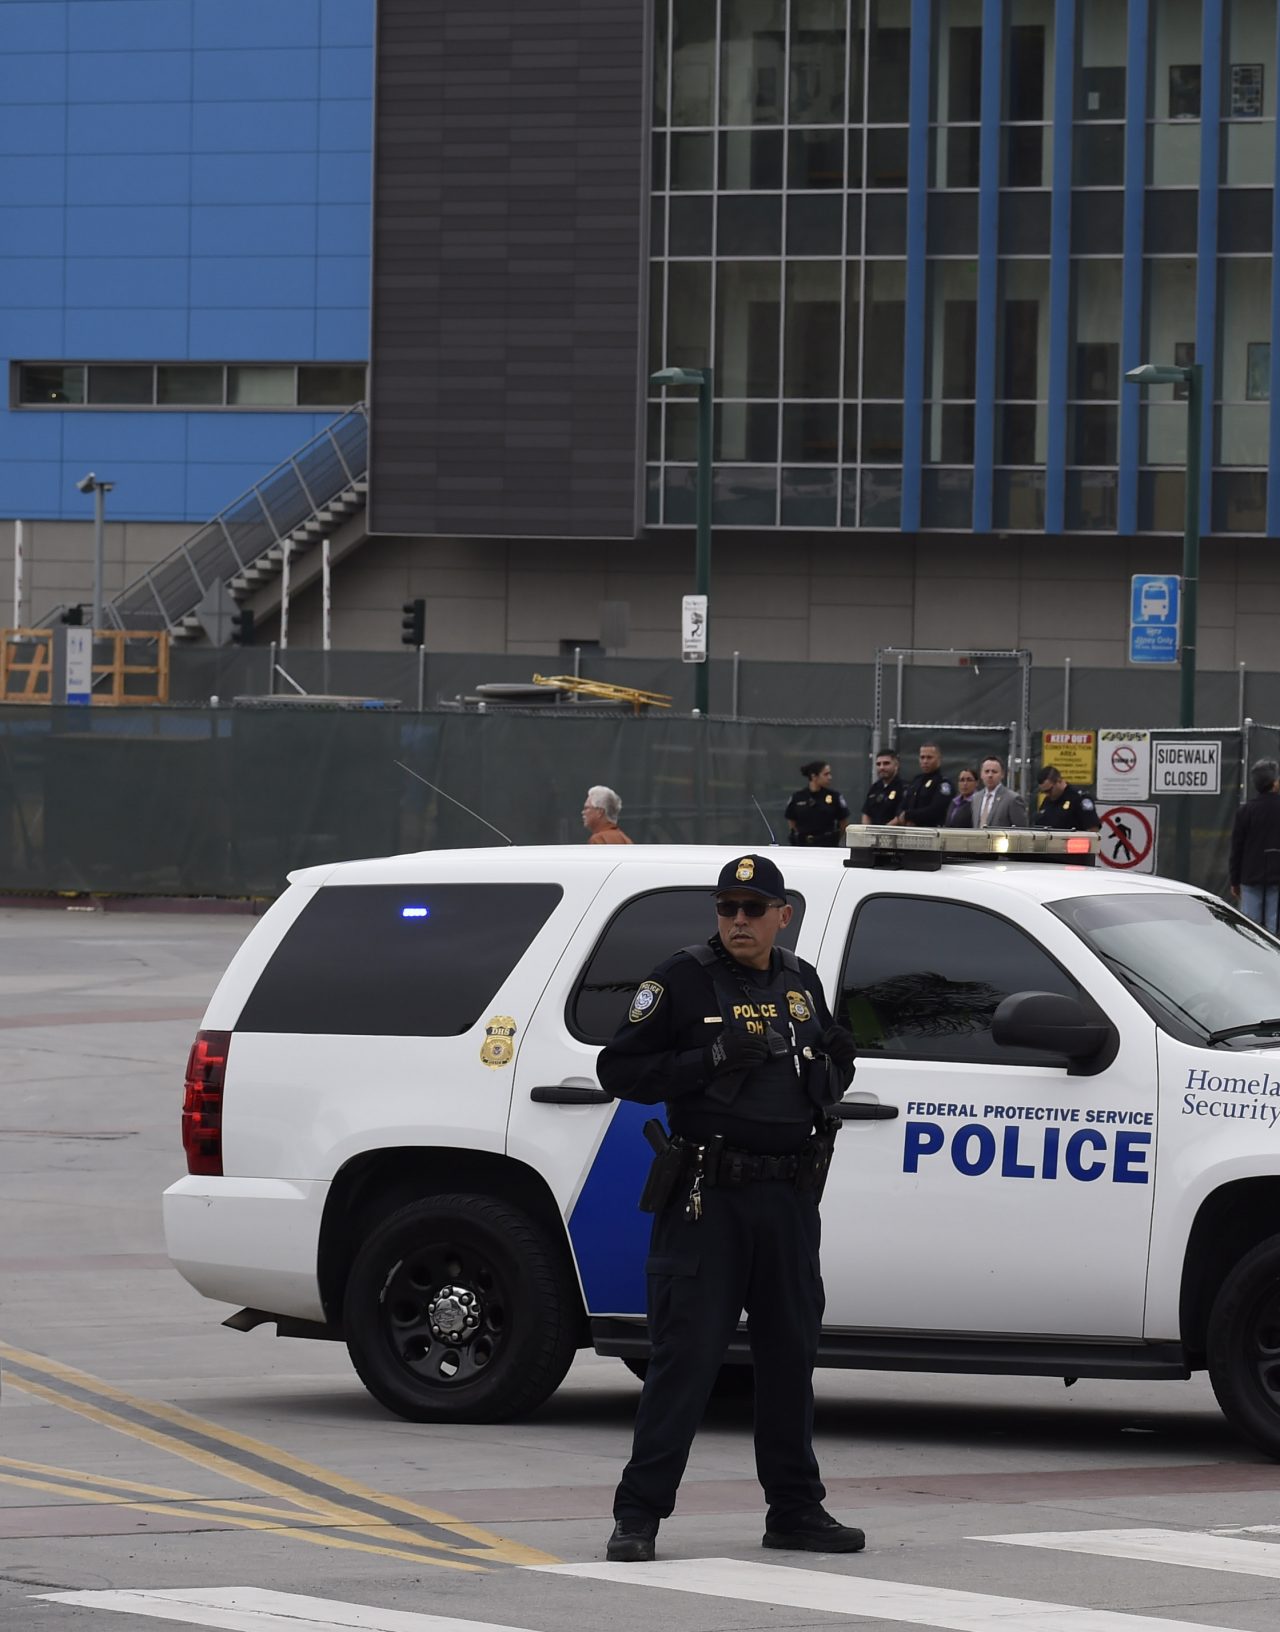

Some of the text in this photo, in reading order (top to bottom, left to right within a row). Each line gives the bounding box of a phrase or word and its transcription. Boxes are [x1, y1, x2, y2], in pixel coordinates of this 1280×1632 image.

[1051, 735, 1087, 743] KEEP OUT
[1158, 749, 1215, 764] SIDEWALK
[1164, 771, 1208, 786] CLOSED
[640, 983, 661, 994] POLICE
[491, 1028, 510, 1036] DHS
[746, 1020, 771, 1034] DH
[906, 1101, 1154, 1126] FEDERAL PROTECTIVE SERVICE
[902, 1121, 1152, 1184] POLICE
